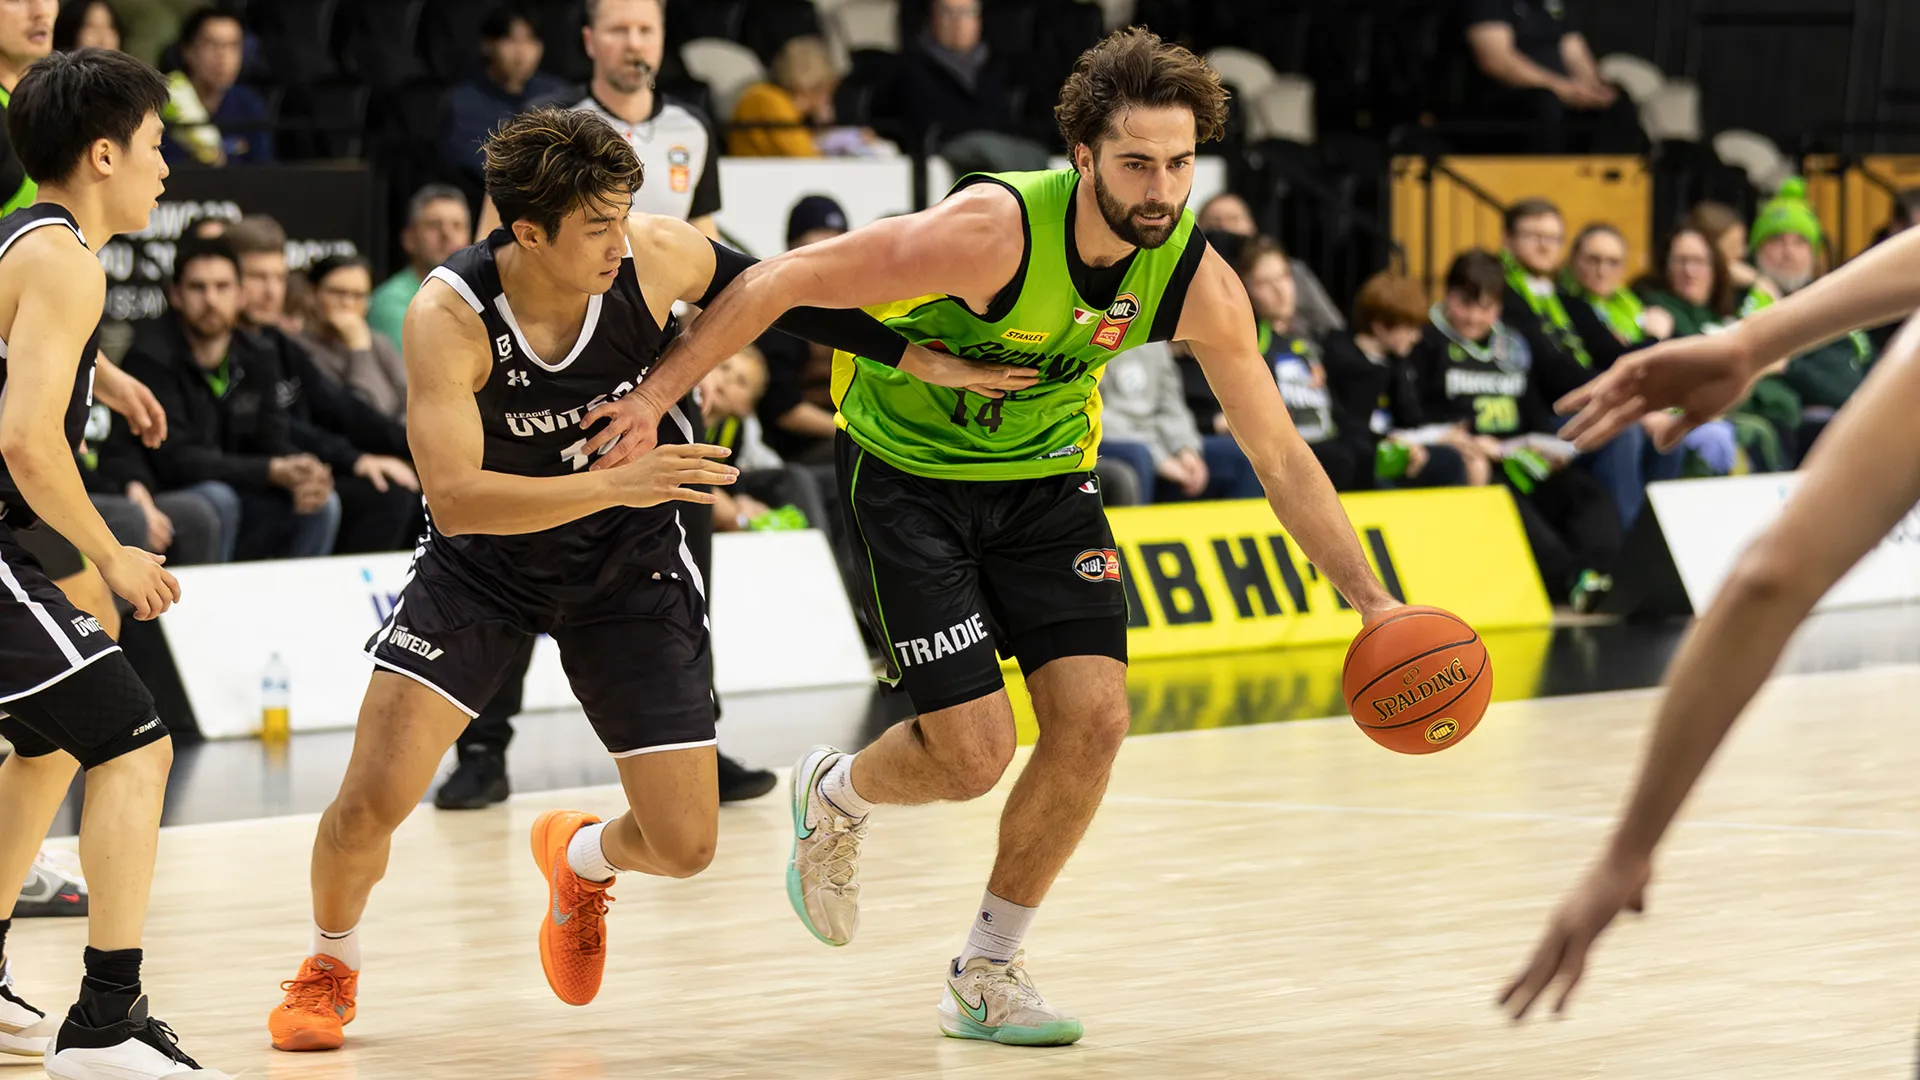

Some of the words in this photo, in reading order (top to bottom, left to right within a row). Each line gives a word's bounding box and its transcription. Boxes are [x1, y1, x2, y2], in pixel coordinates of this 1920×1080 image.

[1109, 302, 1131, 316] NBL
[1006, 331, 1045, 342] STANLEY
[951, 389, 1005, 434] 14
[1080, 558, 1102, 573] NBL
[1210, 527, 1407, 618] HI-I
[895, 612, 988, 667] TRADIE
[1372, 658, 1468, 722] SPALDING
[1432, 725, 1453, 739] NBL
